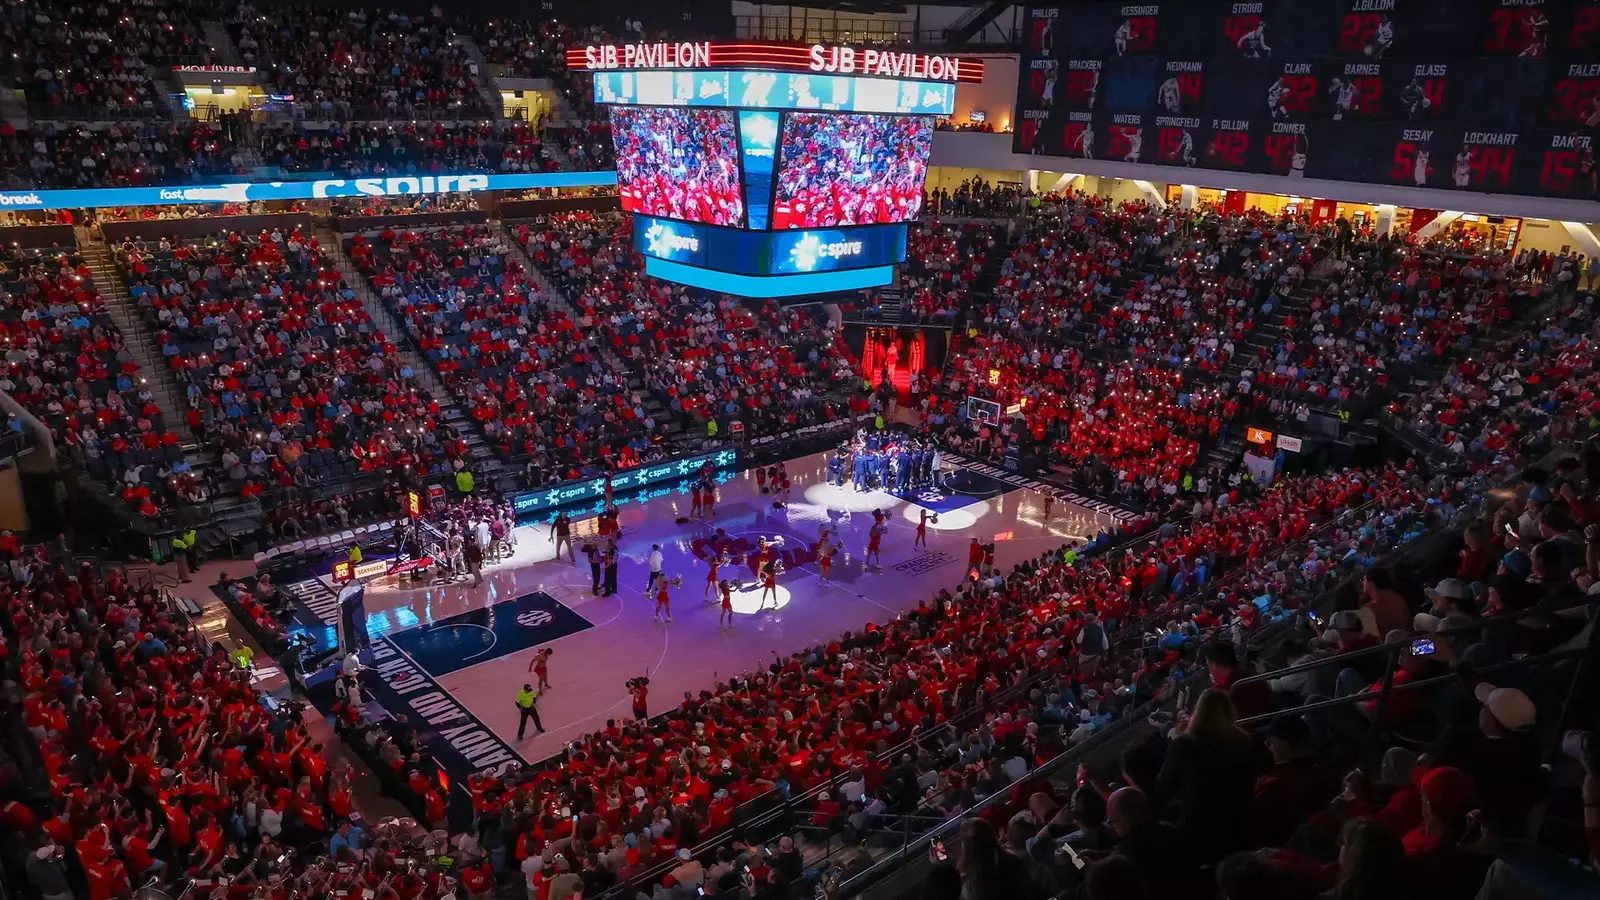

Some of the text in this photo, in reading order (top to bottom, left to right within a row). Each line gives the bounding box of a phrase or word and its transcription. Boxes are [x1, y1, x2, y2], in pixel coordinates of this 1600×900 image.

[1032, 9, 1058, 18] PHILLIPS
[1121, 6, 1158, 17] KESSINGER
[1232, 3, 1263, 14] STROUD
[586, 42, 710, 70] SJB PAVILION
[810, 45, 960, 80] SJB PAVILION
[1166, 61, 1203, 72] NEUMANN
[1284, 63, 1312, 74] CLARK
[1344, 64, 1380, 75] BARNES
[1415, 65, 1446, 76] GLASS
[1113, 114, 1141, 124] WATERS
[1156, 116, 1200, 128] SPRINGFIELD
[1222, 120, 1249, 131] GILLOM
[1272, 122, 1306, 134] CONNER
[1403, 129, 1434, 141] SESAY
[1464, 132, 1518, 146] LOCKHART
[1391, 142, 1417, 180] 5
[1470, 148, 1516, 187] 44
[408, 690, 468, 726] AND
